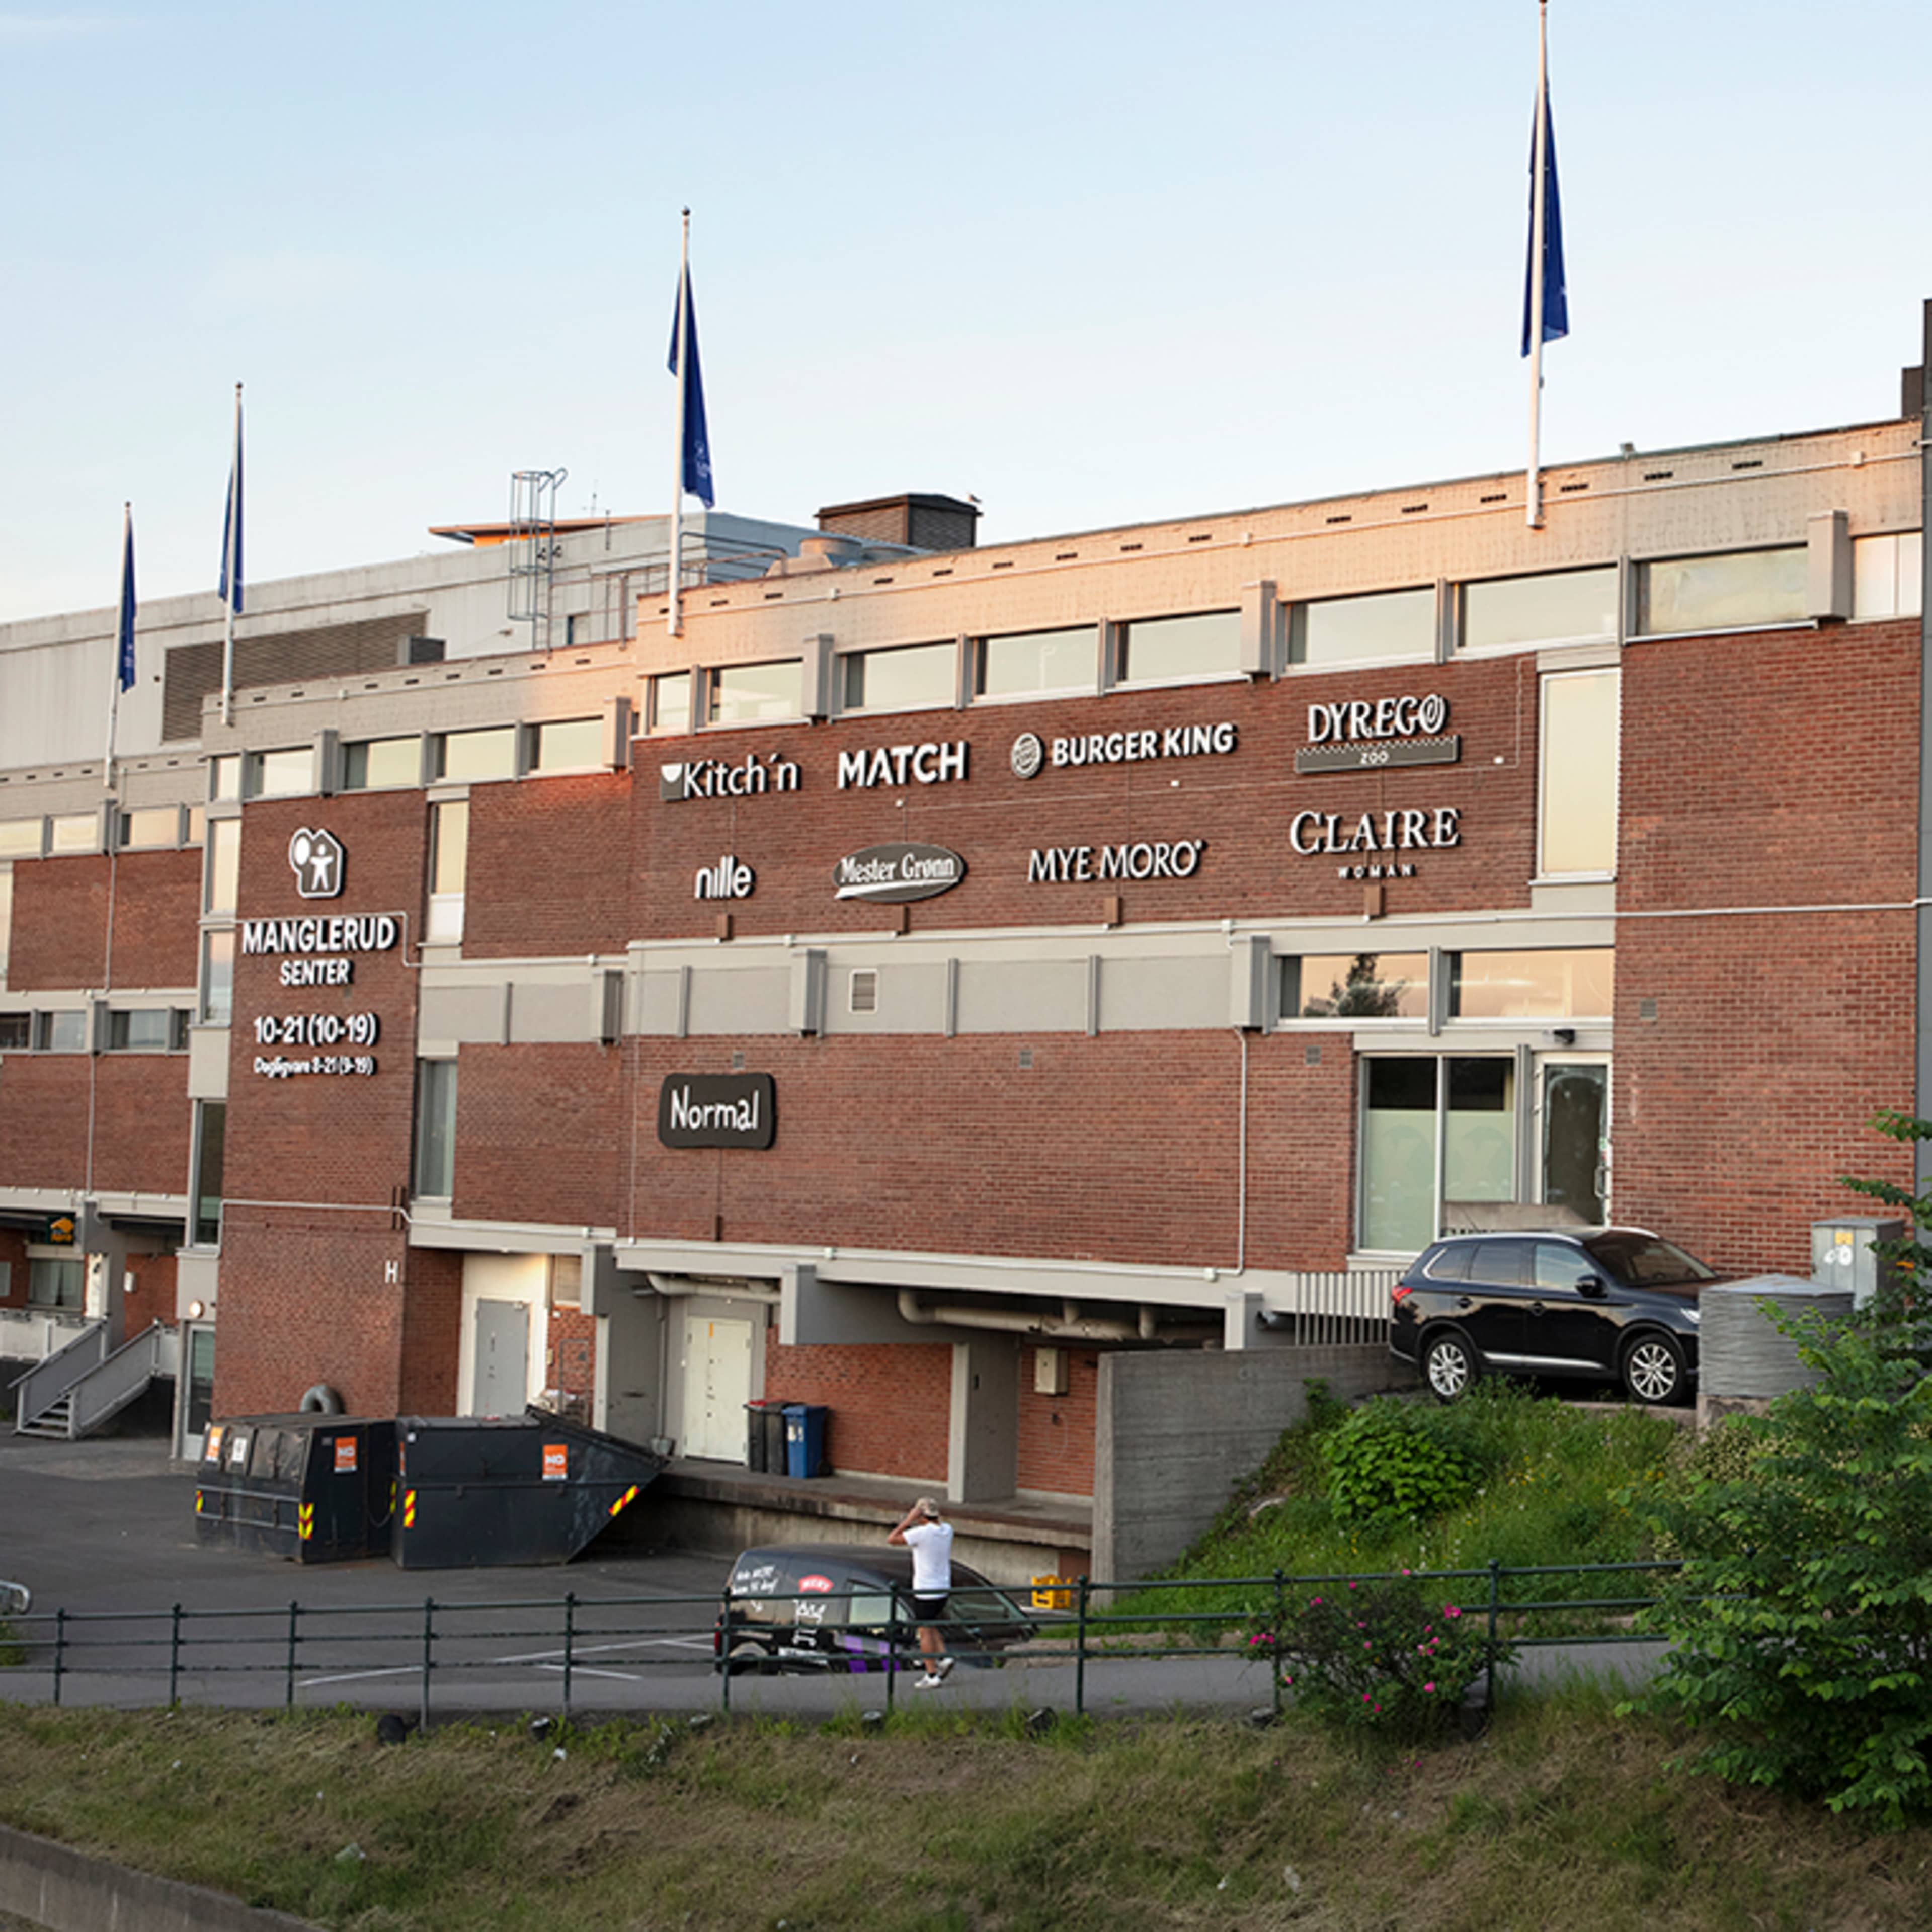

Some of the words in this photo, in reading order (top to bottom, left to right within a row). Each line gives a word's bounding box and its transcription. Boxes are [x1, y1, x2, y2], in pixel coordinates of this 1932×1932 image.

[1308, 694, 1445, 742] DYREGO
[1052, 730, 1158, 766] BURGER
[1163, 722, 1234, 756] KING
[838, 741, 966, 789] MATCH
[1290, 808, 1460, 855] CLAIRE
[695, 854, 753, 899] nille
[840, 856, 897, 883] Mester
[1028, 846, 1091, 881] MYE
[1338, 864, 1412, 878] WOMAN
[243, 916, 396, 954] MANGLERUD
[279, 958, 351, 986] SENTER
[671, 1084, 759, 1132] Normal
[384, 1260, 399, 1284] H
